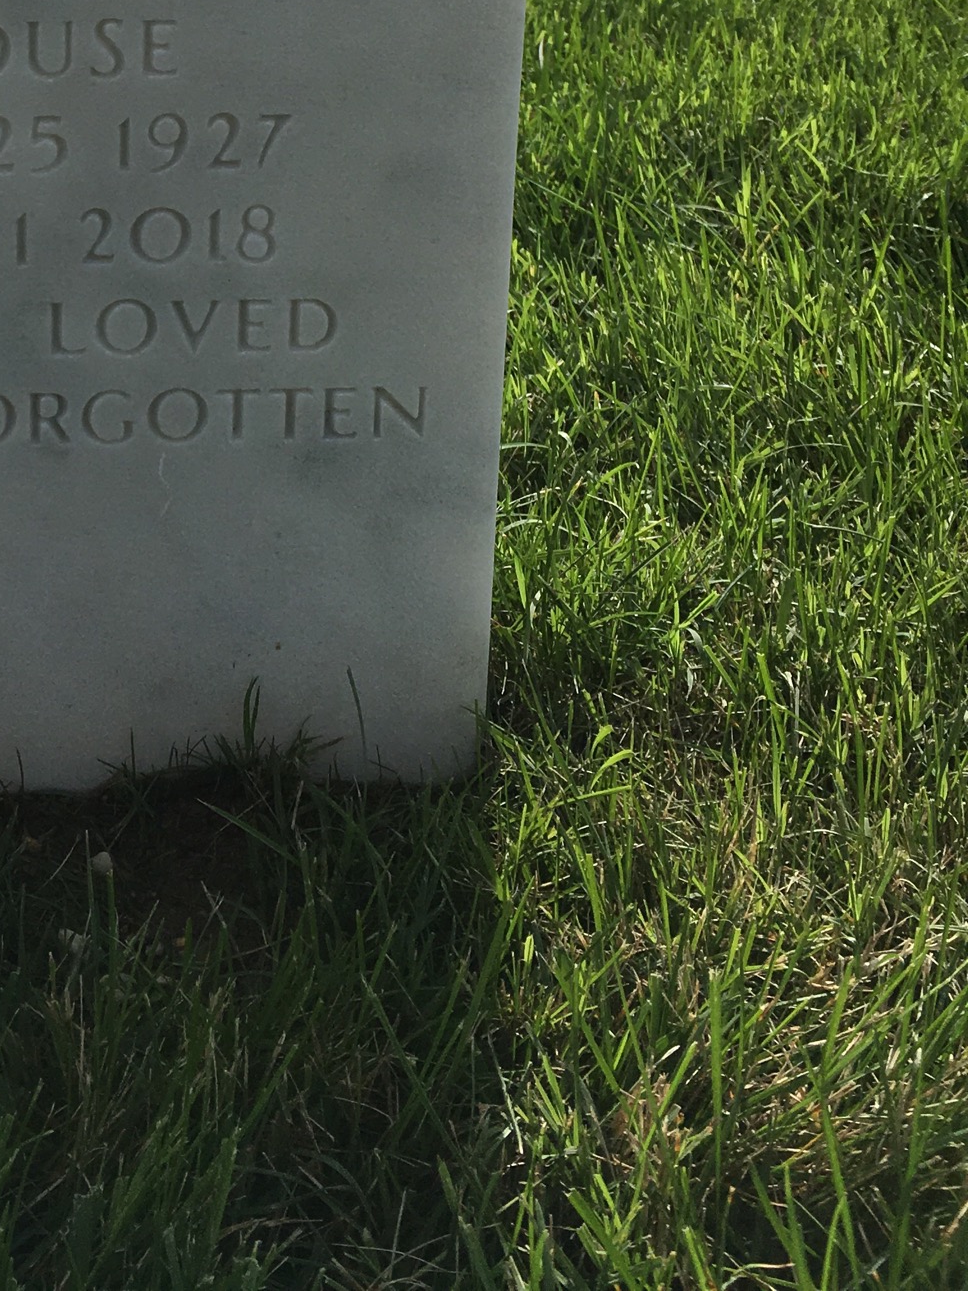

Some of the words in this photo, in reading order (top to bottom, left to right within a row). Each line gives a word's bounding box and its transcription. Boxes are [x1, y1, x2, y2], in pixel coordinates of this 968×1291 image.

[117, 112, 293, 173] 1927
[79, 204, 278, 265] 2018
[49, 296, 339, 358] LOVED
